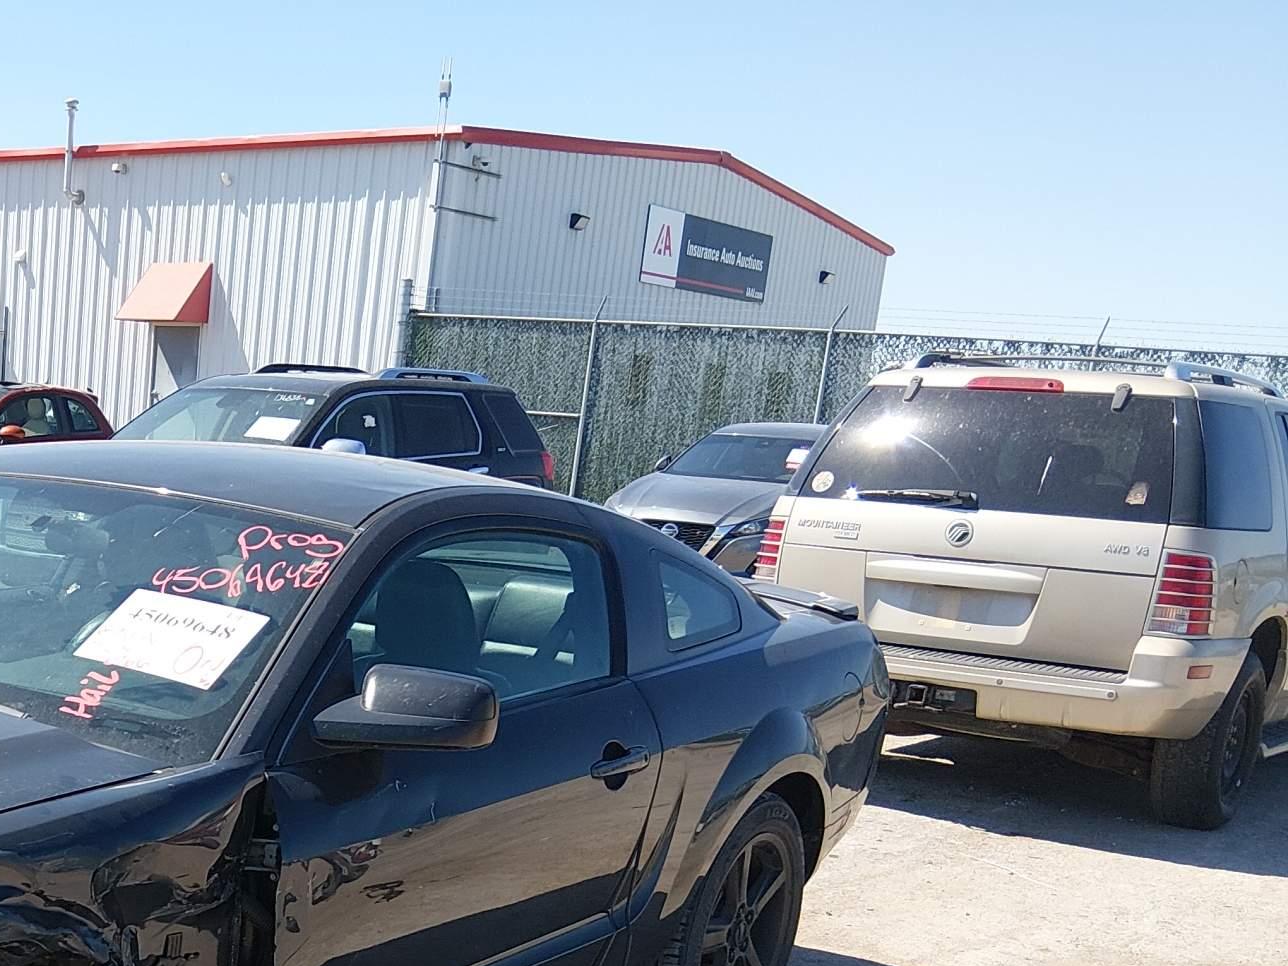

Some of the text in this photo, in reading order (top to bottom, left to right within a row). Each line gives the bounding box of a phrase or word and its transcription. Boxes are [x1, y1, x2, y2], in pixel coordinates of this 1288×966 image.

[686, 239, 764, 272] Insurance Auto Auctions
[798, 519, 862, 532] MOUNTAINEER
[237, 525, 344, 560] Prog
[1103, 543, 1130, 556] AWD
[58, 670, 120, 719] Hail
